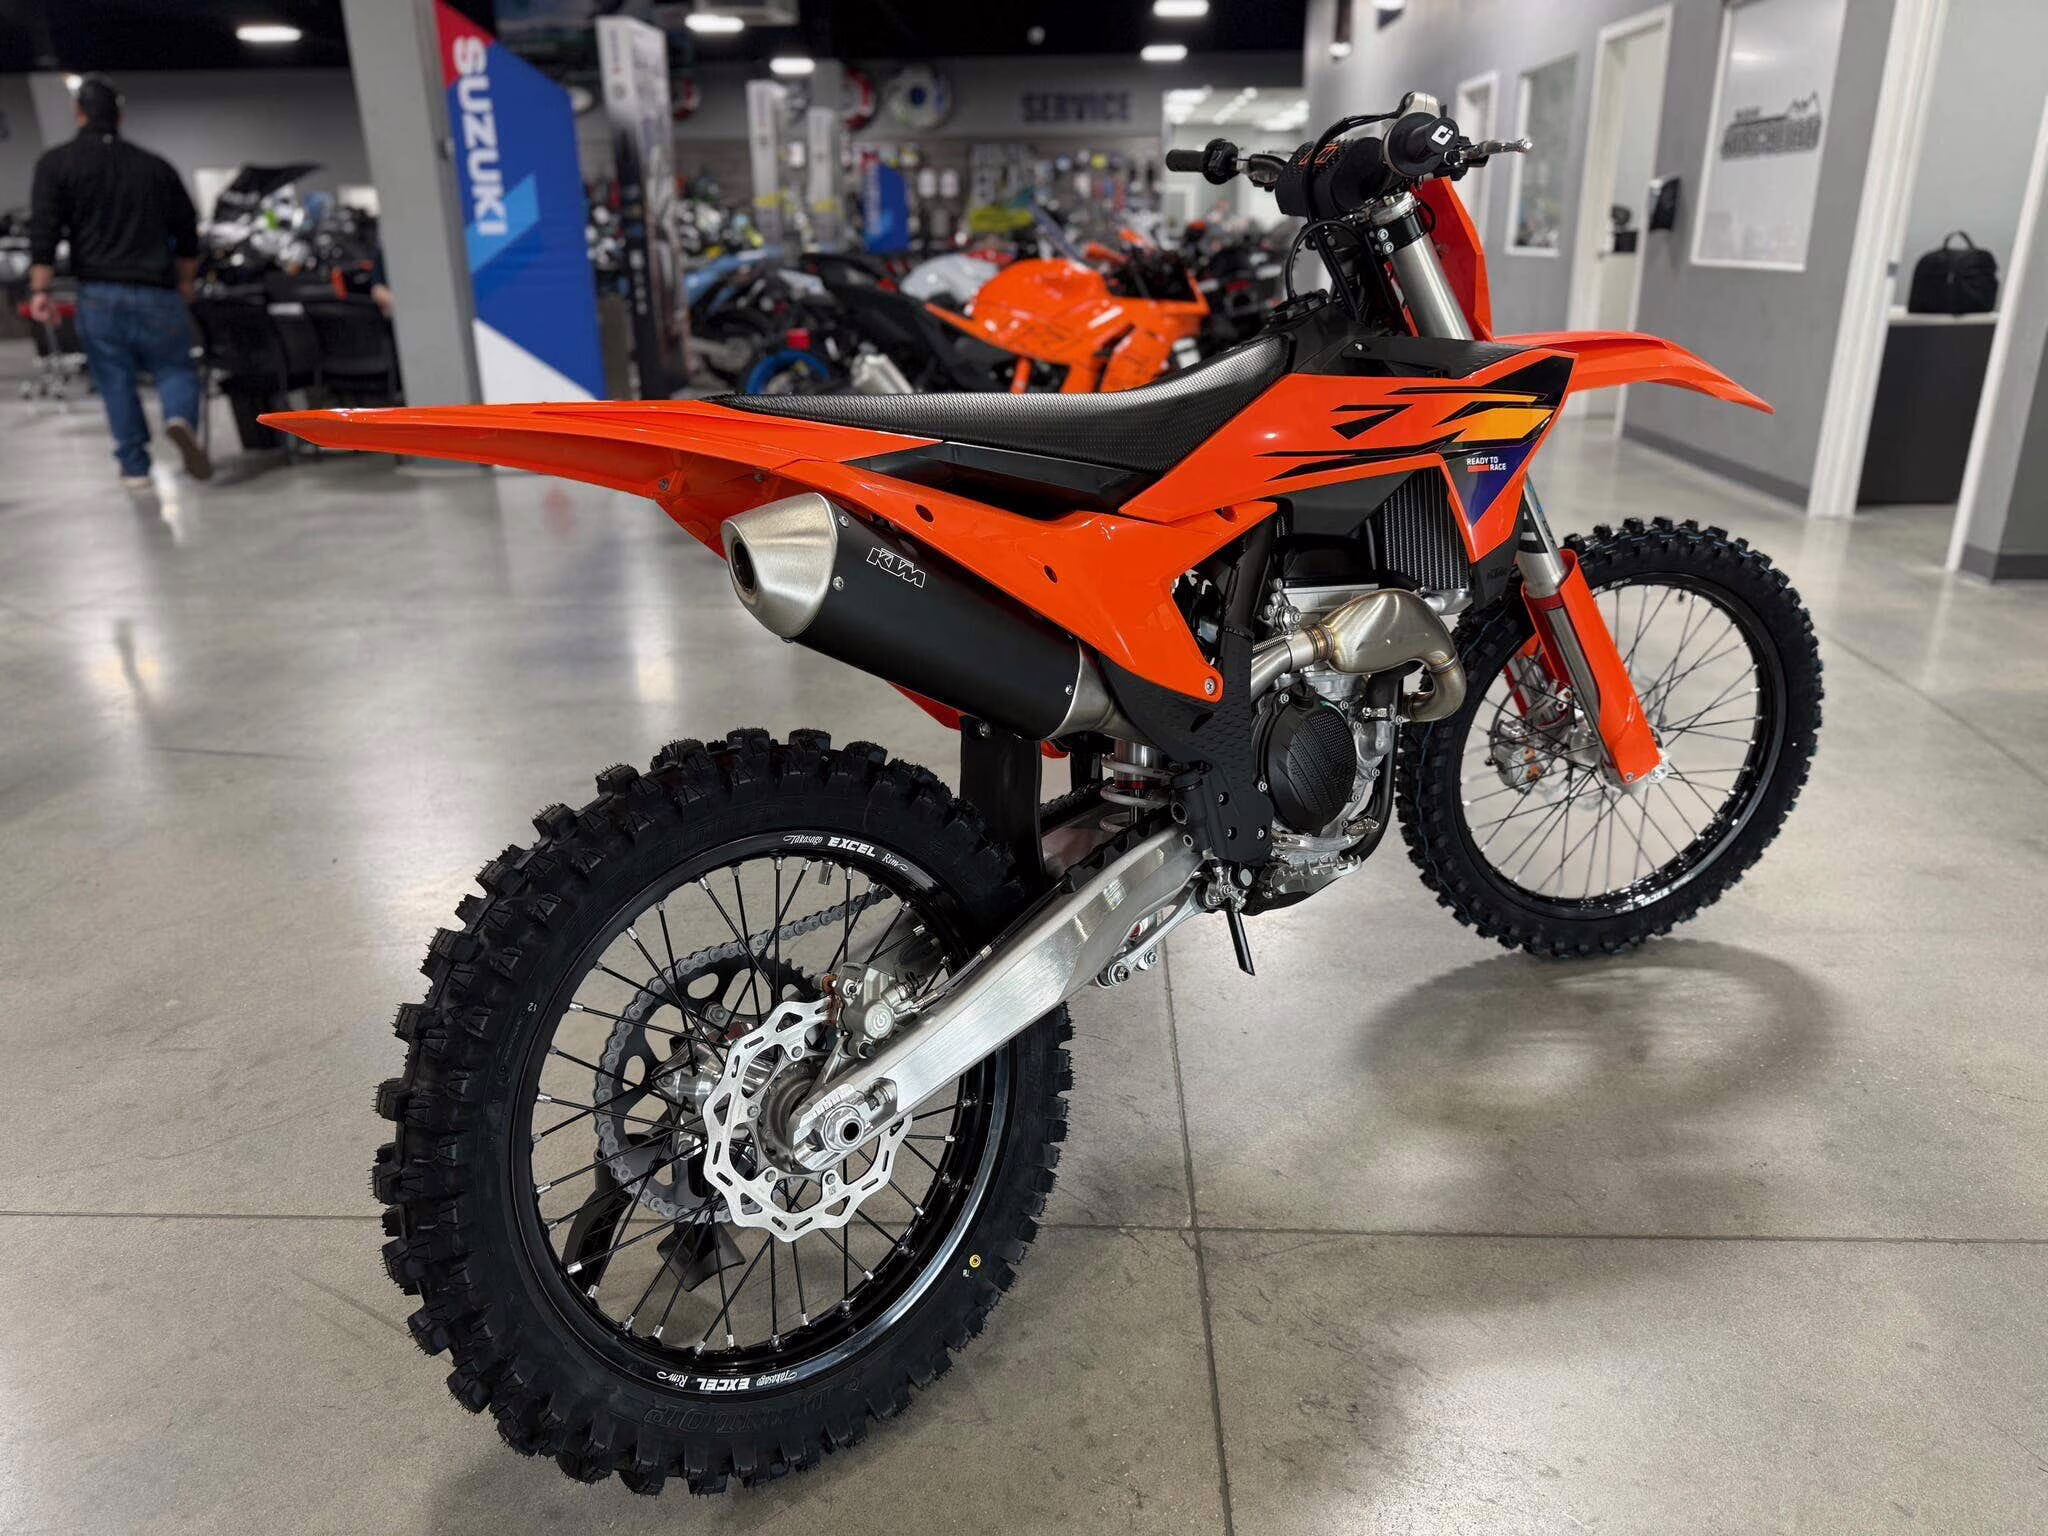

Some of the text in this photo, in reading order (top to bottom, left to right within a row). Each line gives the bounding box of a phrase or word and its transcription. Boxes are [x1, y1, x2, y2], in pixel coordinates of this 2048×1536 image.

[453, 36, 508, 235] SUZUKI
[1467, 456, 1498, 465] READY TO
[1490, 463, 1506, 471] RACE
[866, 547, 926, 588] KTM
[827, 836, 876, 858] EXCEL
[882, 853, 908, 871] Rim
[697, 1377, 750, 1391] EXCEL
